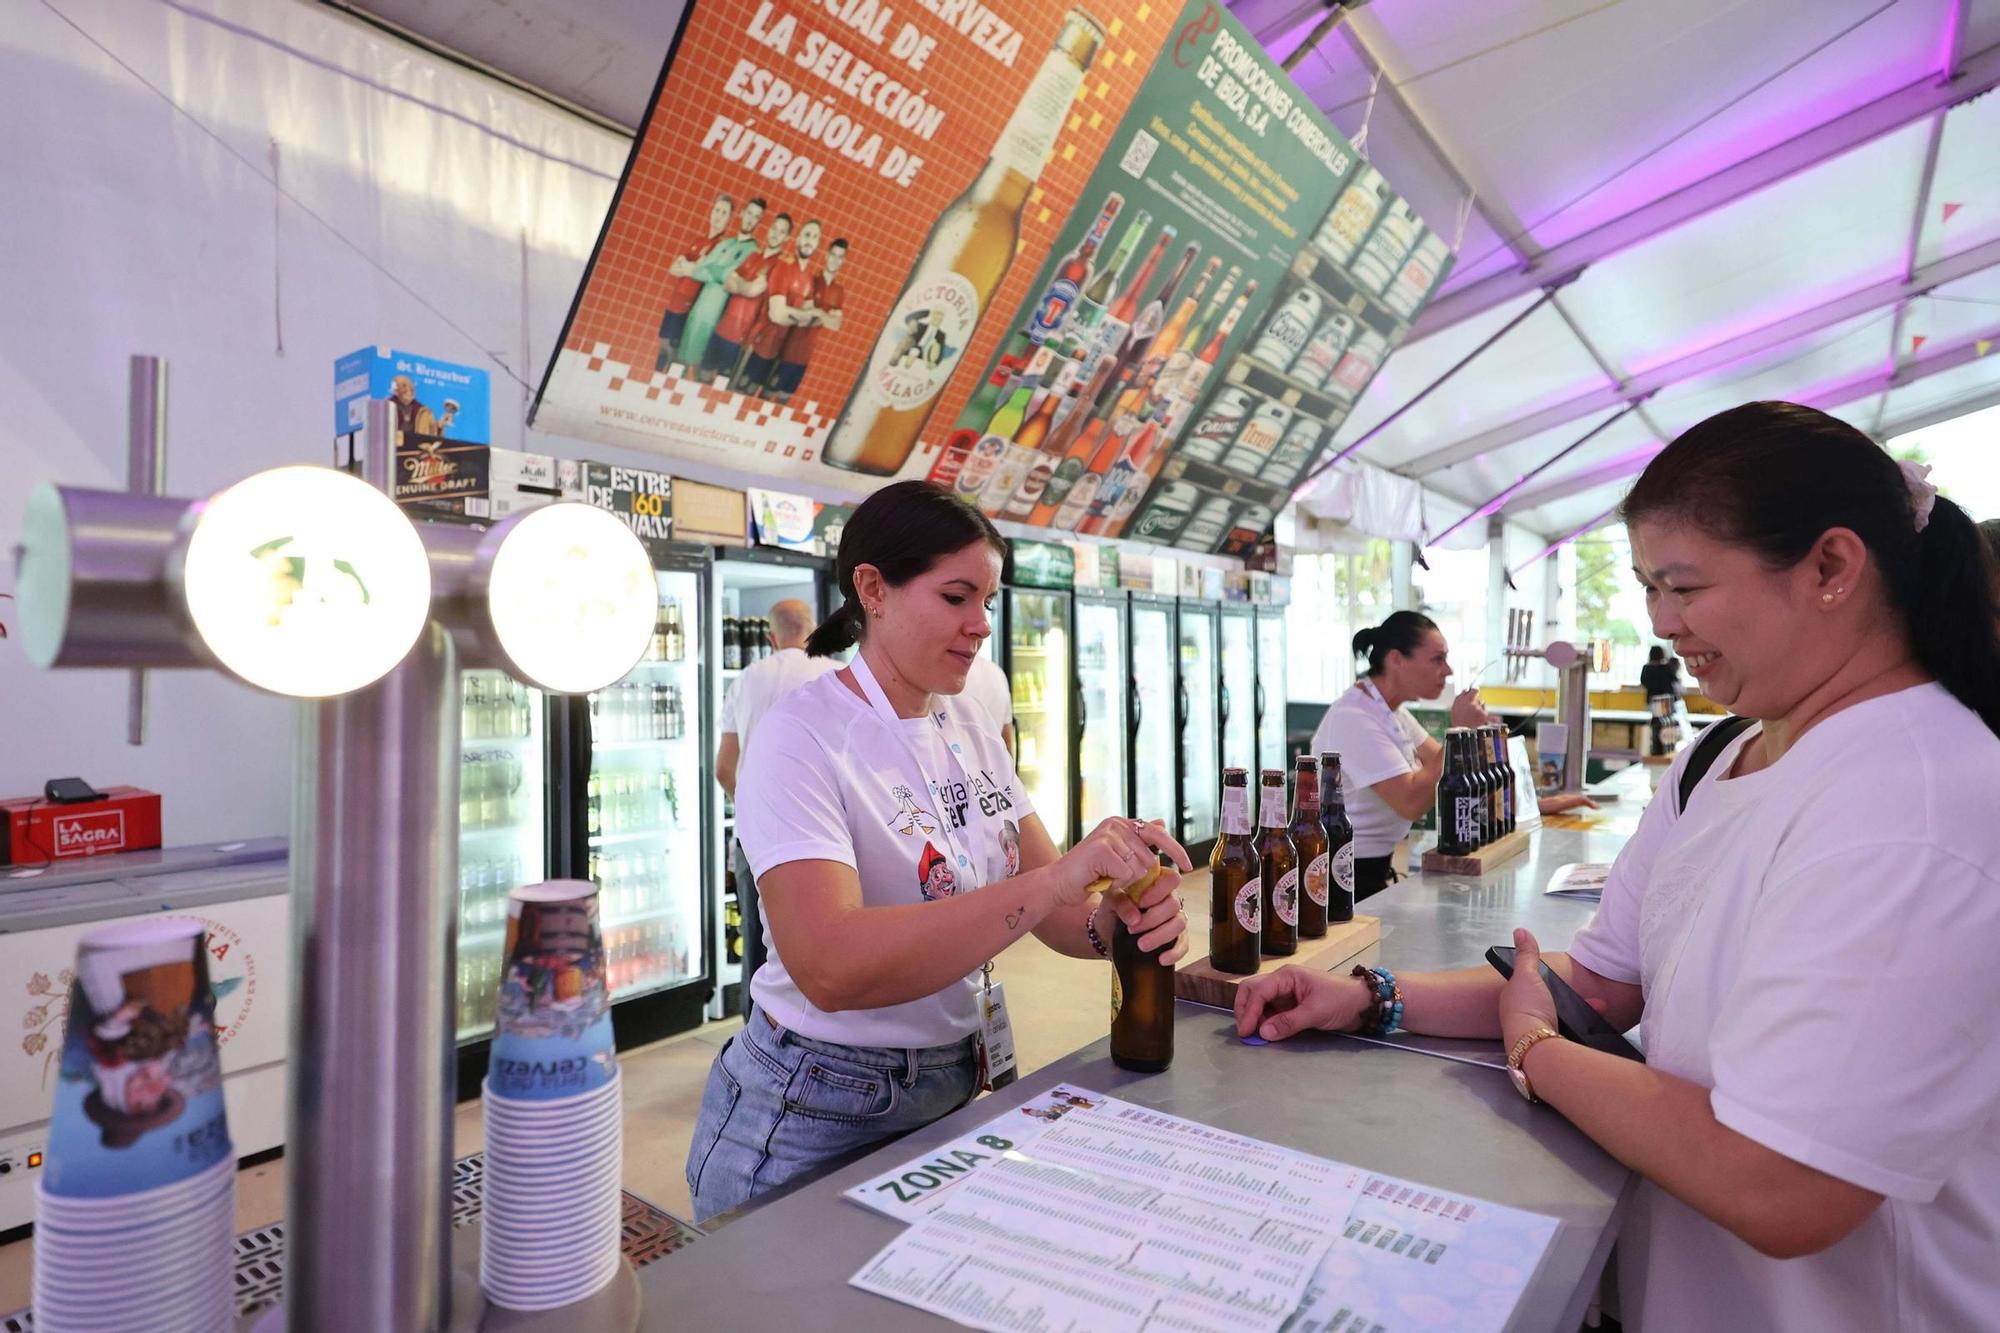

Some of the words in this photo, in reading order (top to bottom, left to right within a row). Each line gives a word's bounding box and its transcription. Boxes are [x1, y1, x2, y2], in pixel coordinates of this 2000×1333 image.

[815, 0, 893, 46] CIAL
[889, 22, 938, 71] DE
[915, 0, 1024, 68] ERVEZA
[745, 0, 798, 56] LA
[795, 31, 945, 141] SELECCIÓN
[1197, 54, 1223, 89] DE
[1210, 28, 1293, 120] PROMOCIONES
[1285, 107, 1349, 177] COMERCIALES
[723, 58, 883, 169] ESPAÑOLA
[878, 145, 925, 189] DE
[701, 115, 826, 199] FÚTBOL
[396, 483, 436, 495] ENUINE
[440, 478, 478, 490] DRAFT
[404, 457, 459, 481] Miller
[610, 466, 671, 497] ESTRE
[588, 485, 614, 510] DE
[932, 778, 967, 804] eria
[944, 790, 1013, 829] ereza
[60, 821, 82, 833] LA
[61, 827, 119, 846] SAGRA
[876, 1150, 992, 1203] ZONA
[976, 1134, 1014, 1151] 8
